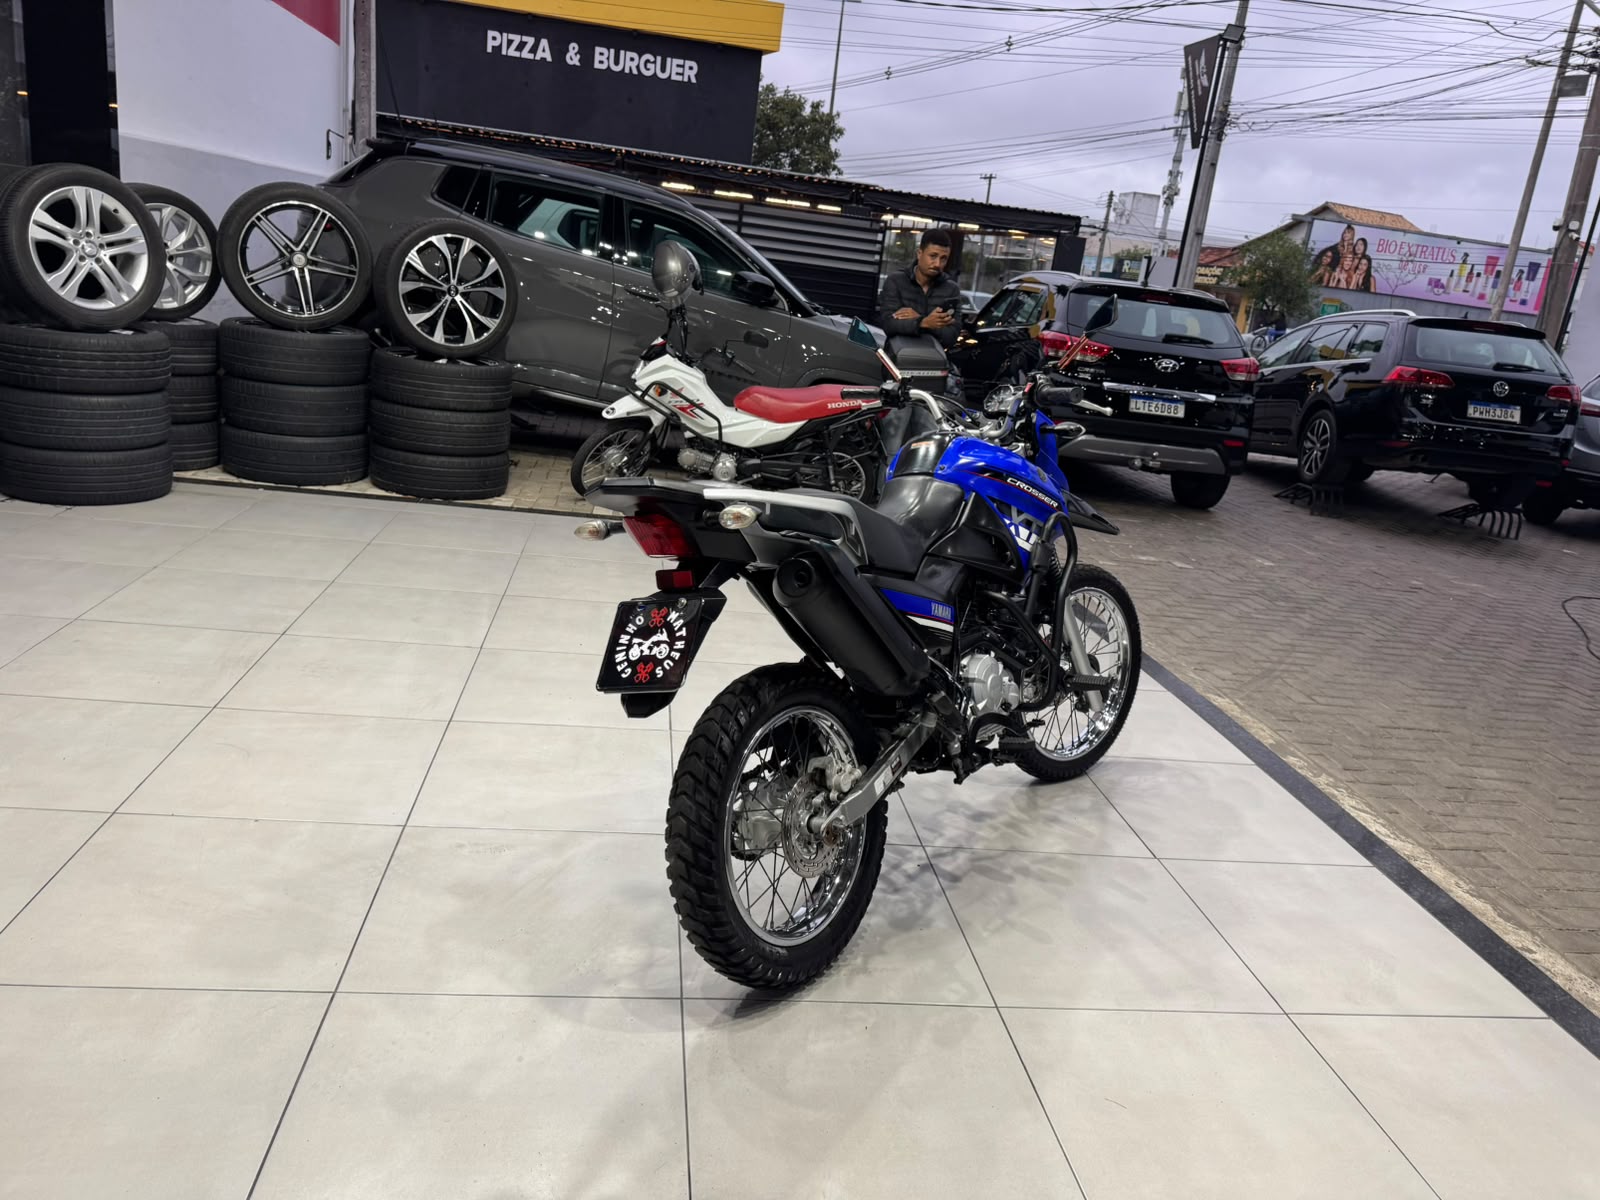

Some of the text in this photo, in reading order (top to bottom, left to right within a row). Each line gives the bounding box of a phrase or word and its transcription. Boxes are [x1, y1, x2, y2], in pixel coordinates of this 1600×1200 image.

[486, 29, 698, 83] PIZZA & BURGUER
[1376, 238, 1457, 264] BIO EXTRATUS
[826, 400, 863, 410] HONDA
[1134, 401, 1179, 415] LTE6D88
[1472, 406, 1515, 419] PWH3J84
[1006, 477, 1059, 508] CROSSER
[615, 615, 645, 678] GENINHO
[655, 610, 687, 678] MATHEUS
